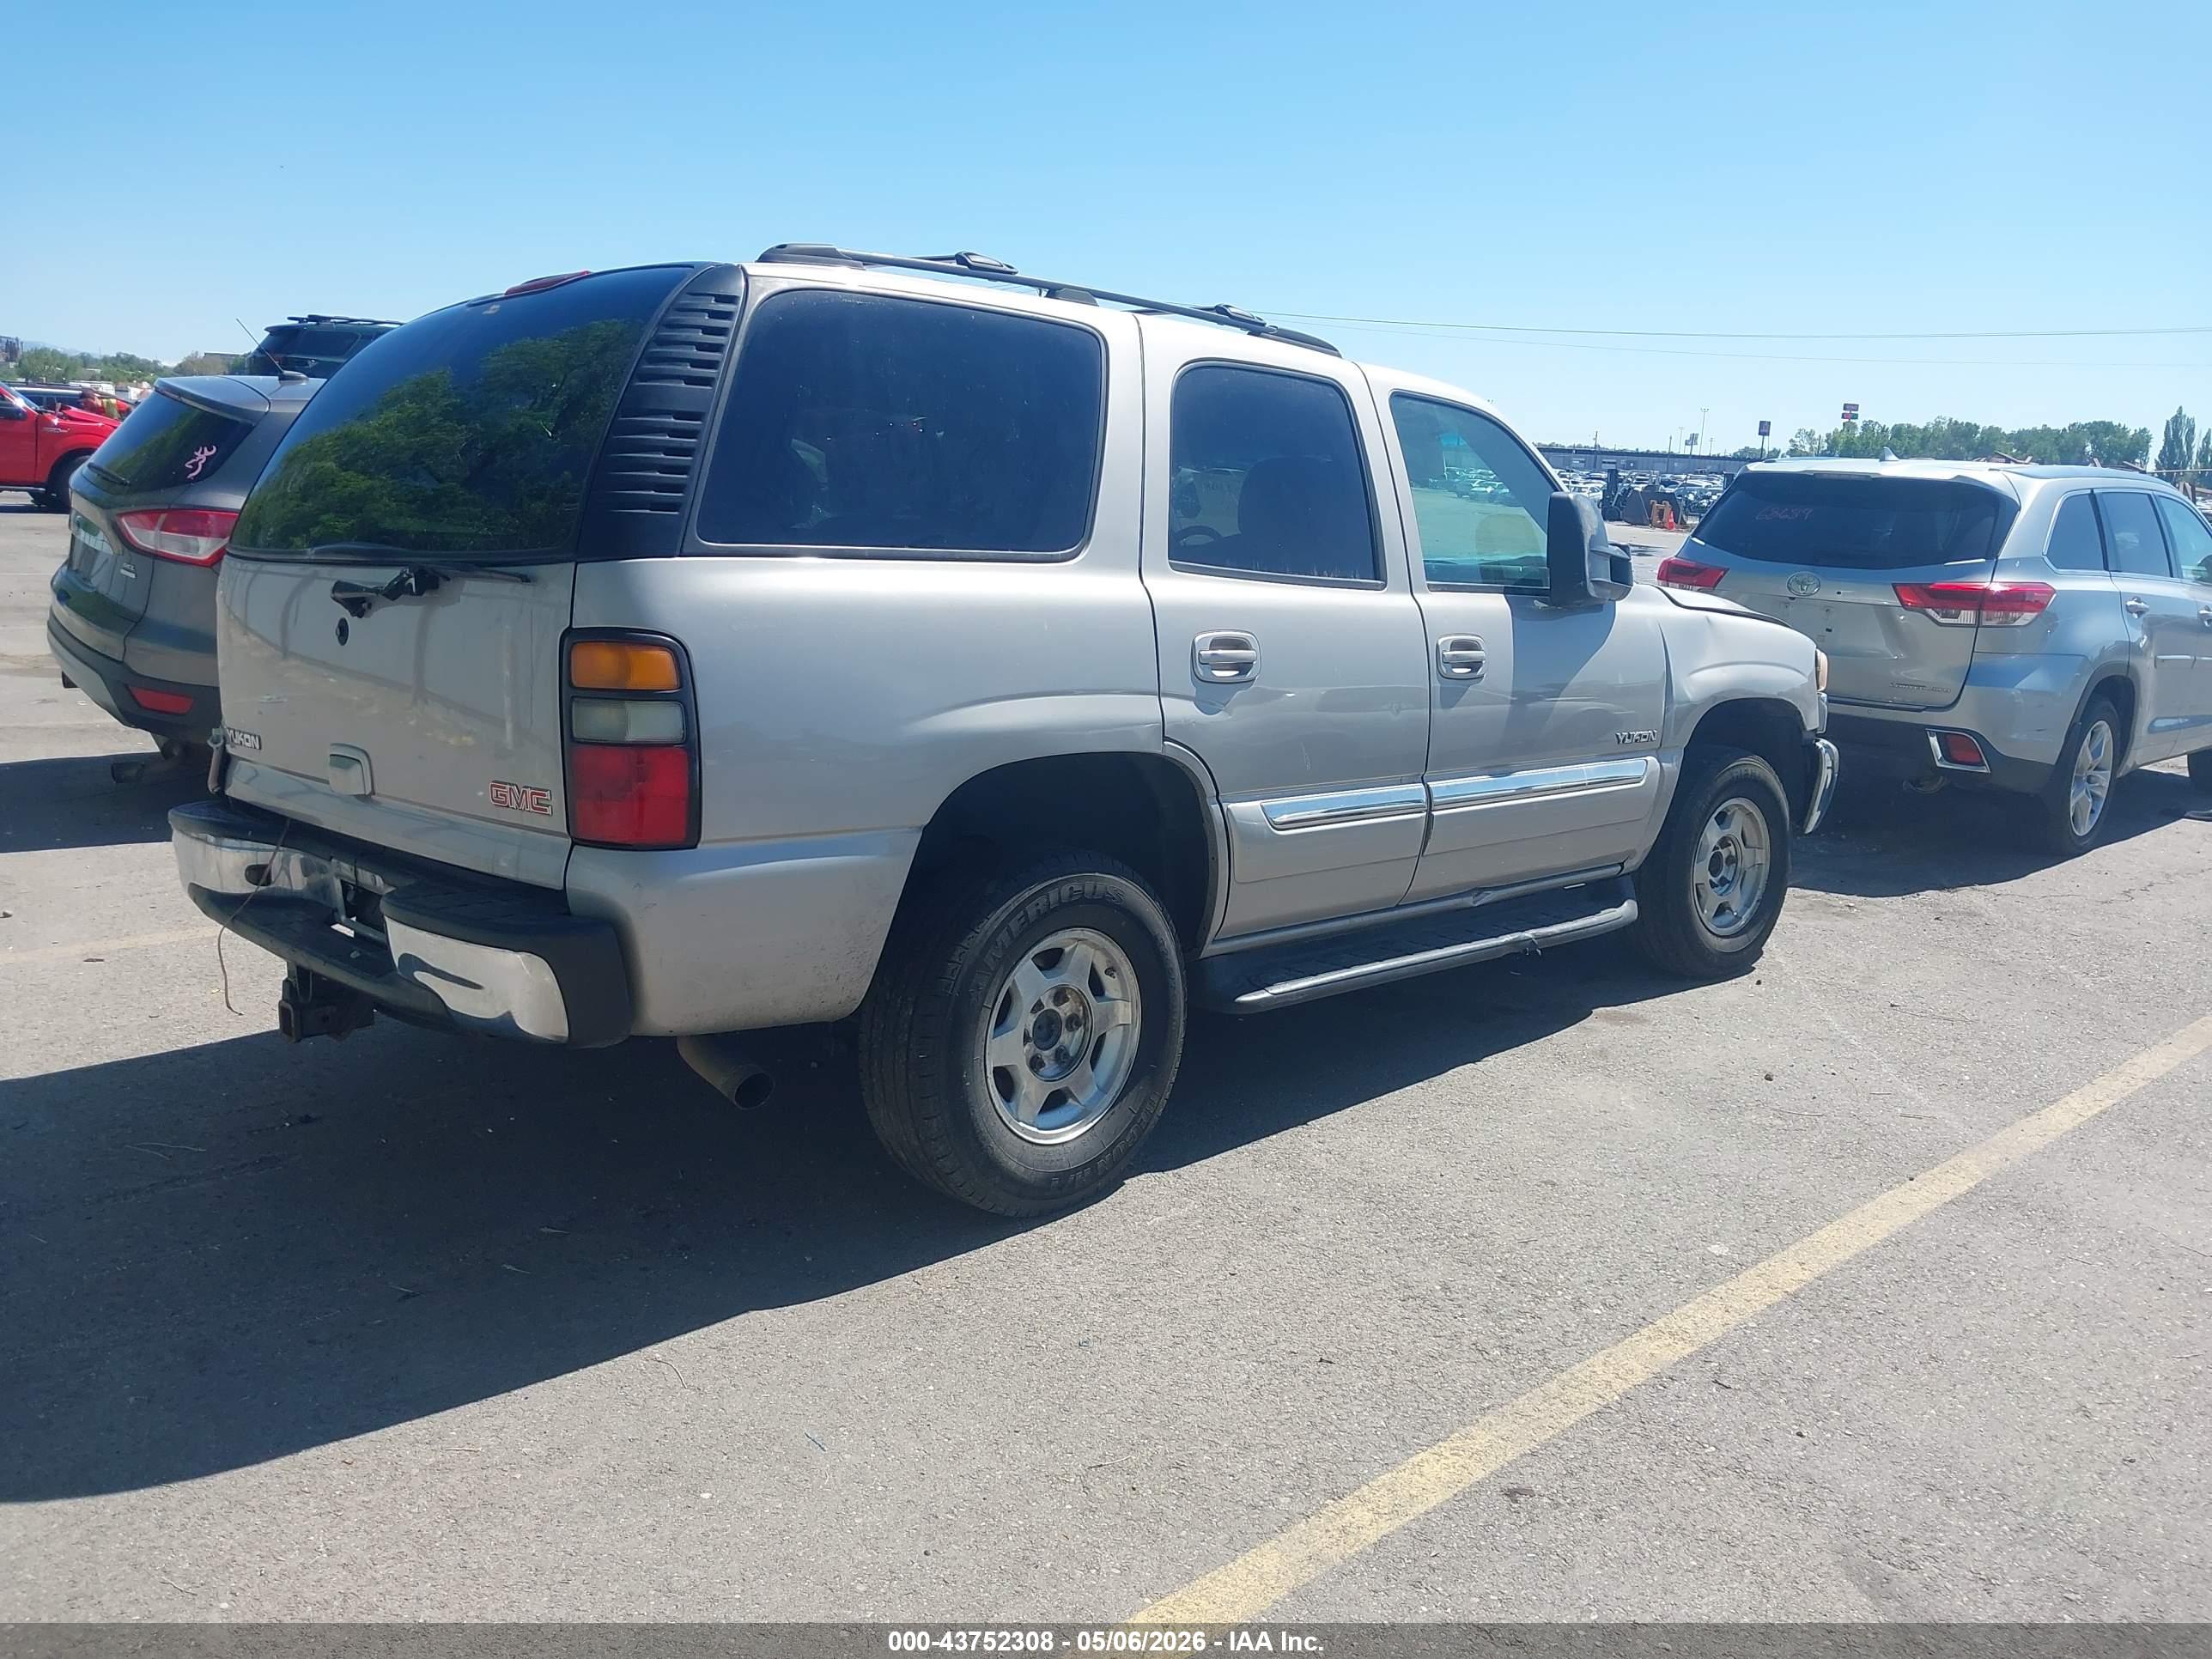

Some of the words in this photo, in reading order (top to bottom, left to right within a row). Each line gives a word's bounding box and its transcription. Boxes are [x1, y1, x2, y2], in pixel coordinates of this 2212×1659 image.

[226, 728, 262, 750] YUKON
[1614, 730, 1658, 744] YUKON
[489, 781, 553, 817] GMC
